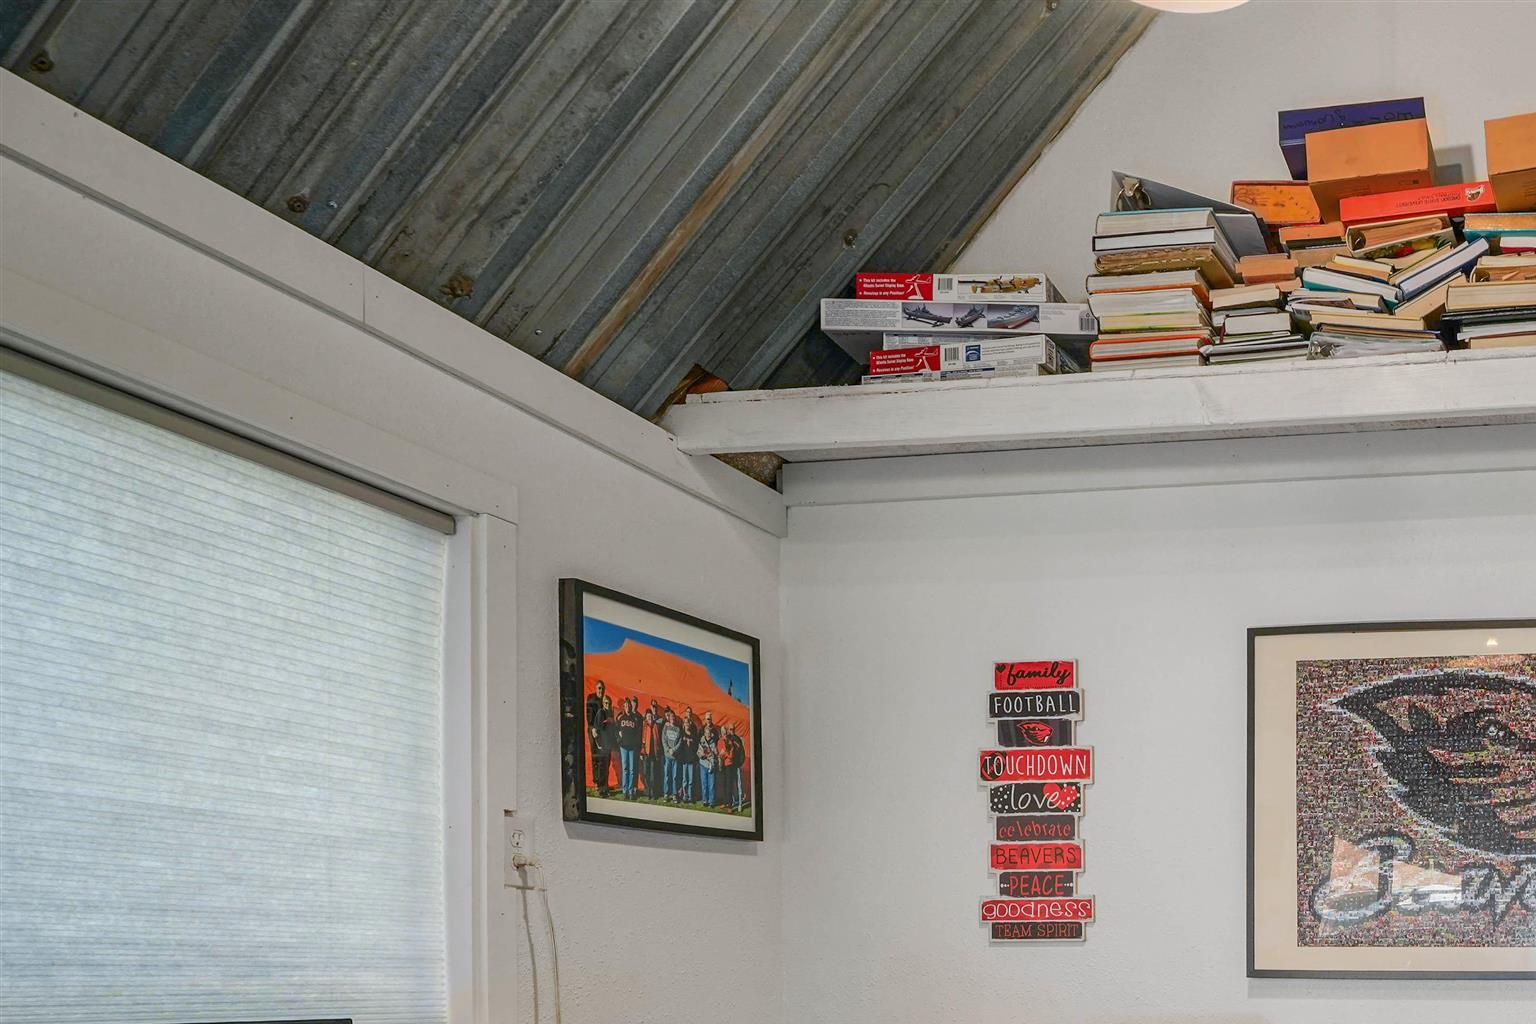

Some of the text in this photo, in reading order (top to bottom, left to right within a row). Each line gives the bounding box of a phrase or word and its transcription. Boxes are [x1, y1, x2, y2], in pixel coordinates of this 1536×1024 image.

[1006, 661, 1071, 686] family
[993, 694, 1077, 714] FOOTBALL
[983, 754, 1087, 777] TOUCHDOWN
[1008, 784, 1063, 811] love
[999, 820, 1071, 838] celebrate
[995, 846, 1077, 865] BEAVERS
[1008, 875, 1065, 896] PEACE
[982, 900, 1091, 920] goodness
[995, 923, 1079, 939] TEAM SPIRIT
